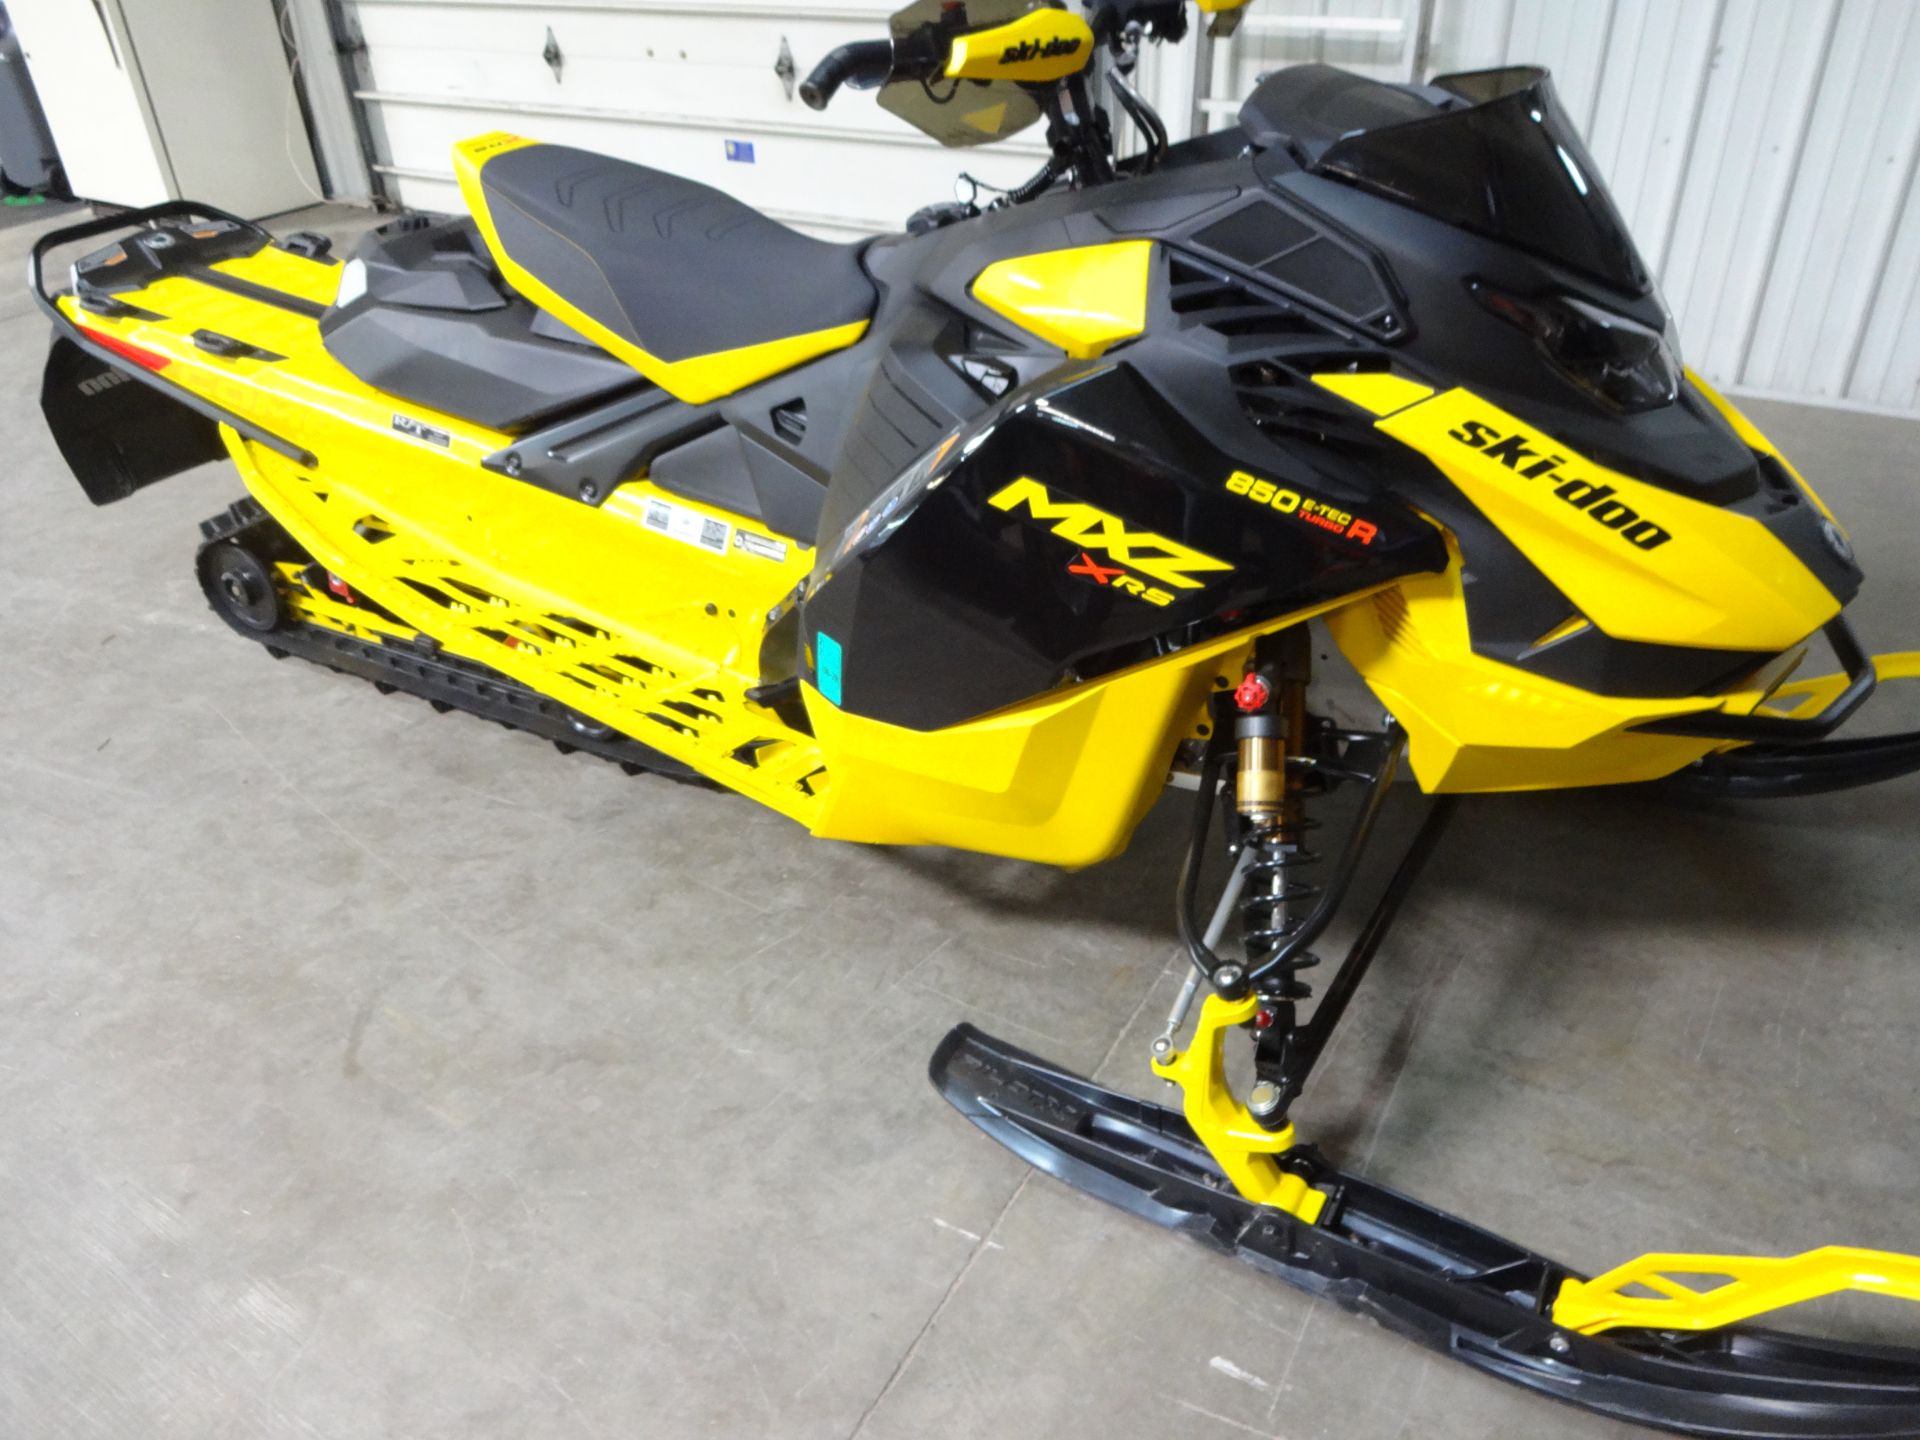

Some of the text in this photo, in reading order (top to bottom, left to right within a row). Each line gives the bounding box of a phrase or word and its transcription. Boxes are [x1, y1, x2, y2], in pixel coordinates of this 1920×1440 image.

[988, 476, 1235, 588] MXZ
[1225, 470, 1301, 514] 850
[1302, 498, 1352, 526] E-TEC
[1345, 517, 1378, 545] R
[1448, 420, 1673, 551] ski-doo
